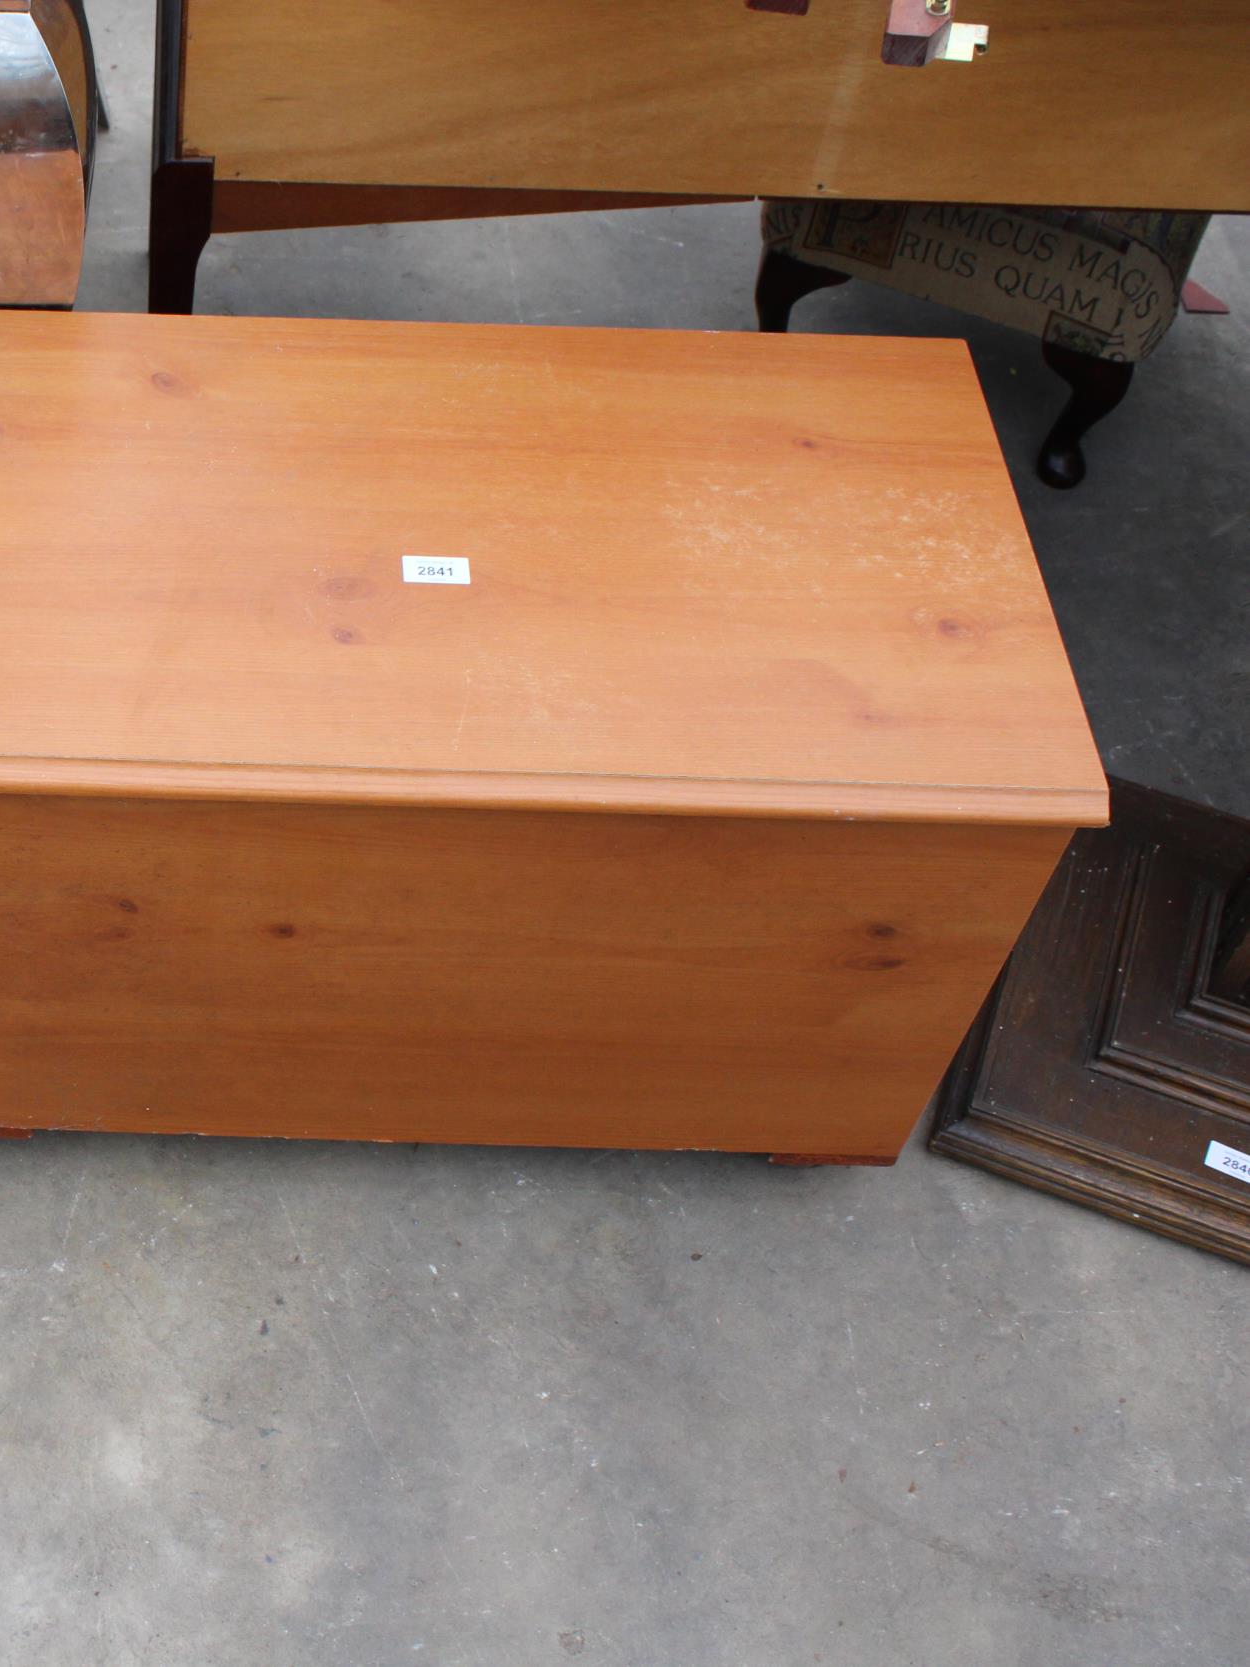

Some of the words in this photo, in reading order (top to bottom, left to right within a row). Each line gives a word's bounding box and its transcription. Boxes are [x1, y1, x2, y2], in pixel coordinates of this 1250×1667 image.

[899, 231, 977, 279] RIUS
[994, 265, 1101, 323] QUAM
[921, 204, 1060, 262] AMICUS
[1066, 244, 1159, 319] MAGIS
[417, 565, 454, 577] 2841
